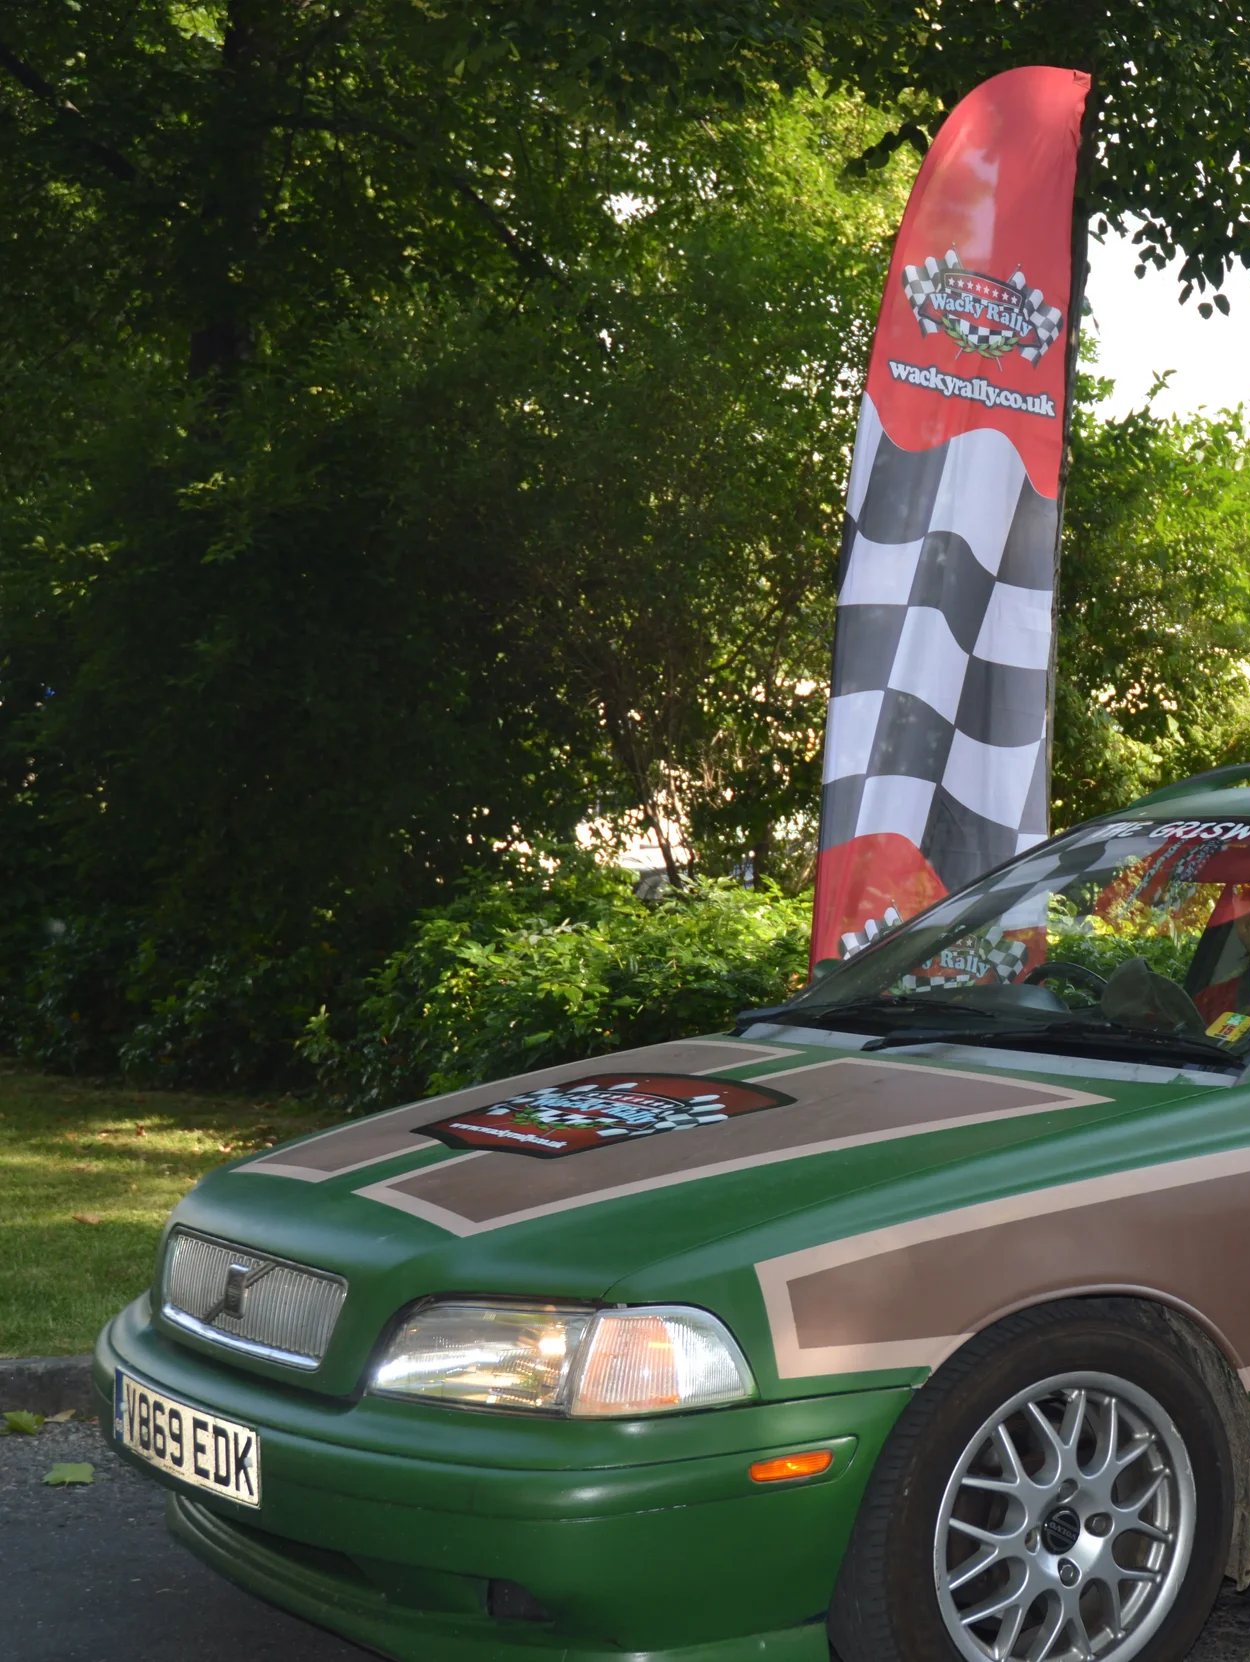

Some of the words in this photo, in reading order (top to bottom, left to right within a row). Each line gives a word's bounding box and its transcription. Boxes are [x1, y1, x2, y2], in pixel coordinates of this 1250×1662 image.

[929, 293, 986, 319] Wacky
[986, 303, 1033, 337] Rally
[888, 360, 1056, 417] wackyrally.co.uk
[1091, 821, 1154, 838] THE
[939, 949, 991, 978] Rally
[126, 1382, 184, 1468] V869
[192, 1416, 255, 1497] EDK
[1049, 1521, 1077, 1541] VOLVO
